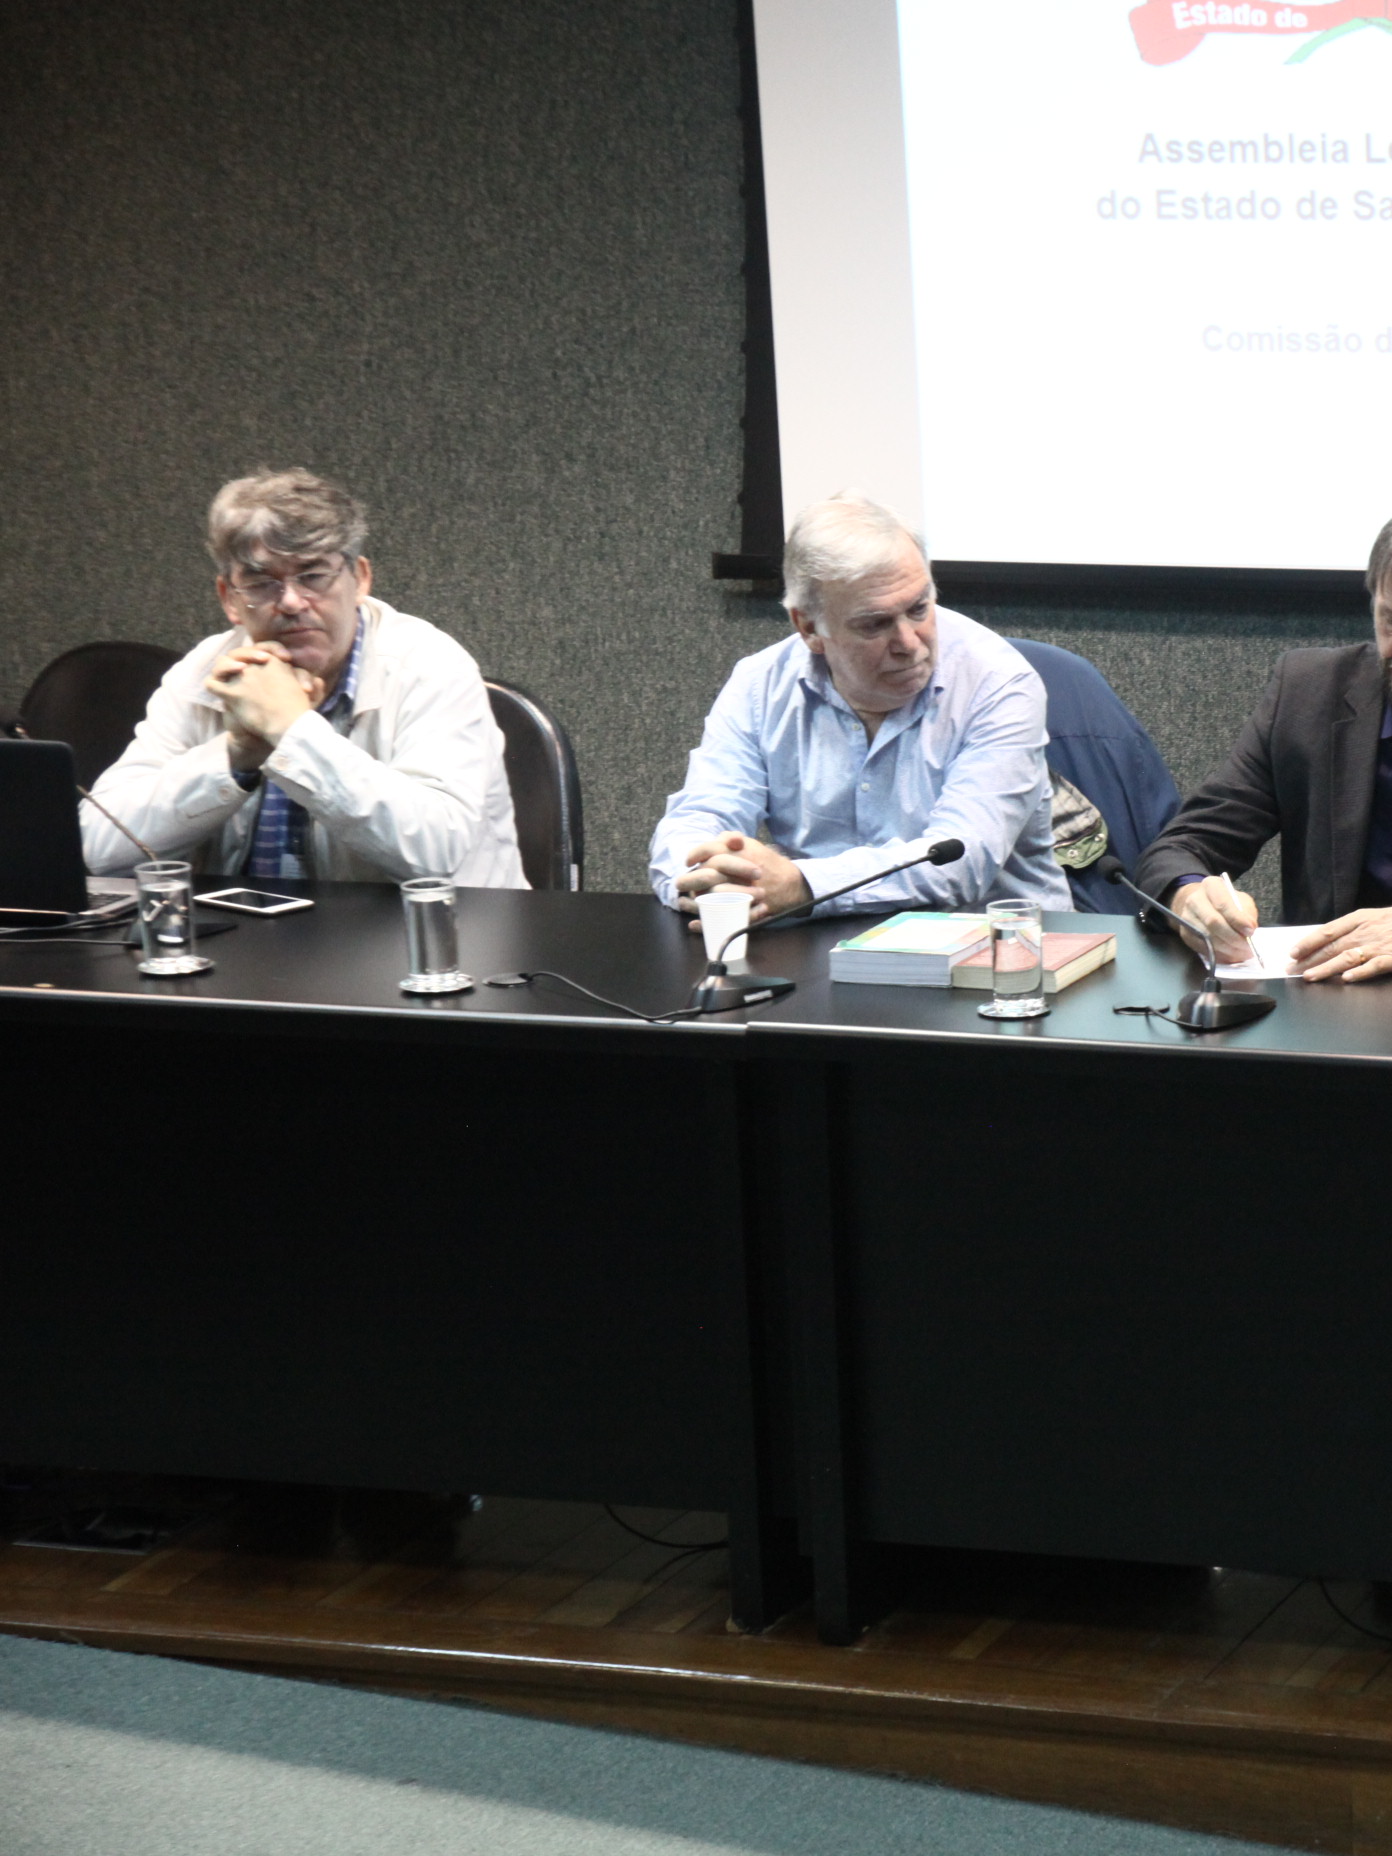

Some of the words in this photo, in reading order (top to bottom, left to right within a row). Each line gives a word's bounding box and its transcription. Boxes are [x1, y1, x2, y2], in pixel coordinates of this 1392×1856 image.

[1172, 1, 1268, 29] Estado
[1274, 8, 1308, 28] de
[1138, 132, 1350, 164] Assembleia
[1097, 190, 1142, 220] do
[1155, 190, 1282, 221] Estado
[1296, 190, 1338, 221] de
[1202, 324, 1363, 352] Comissão
